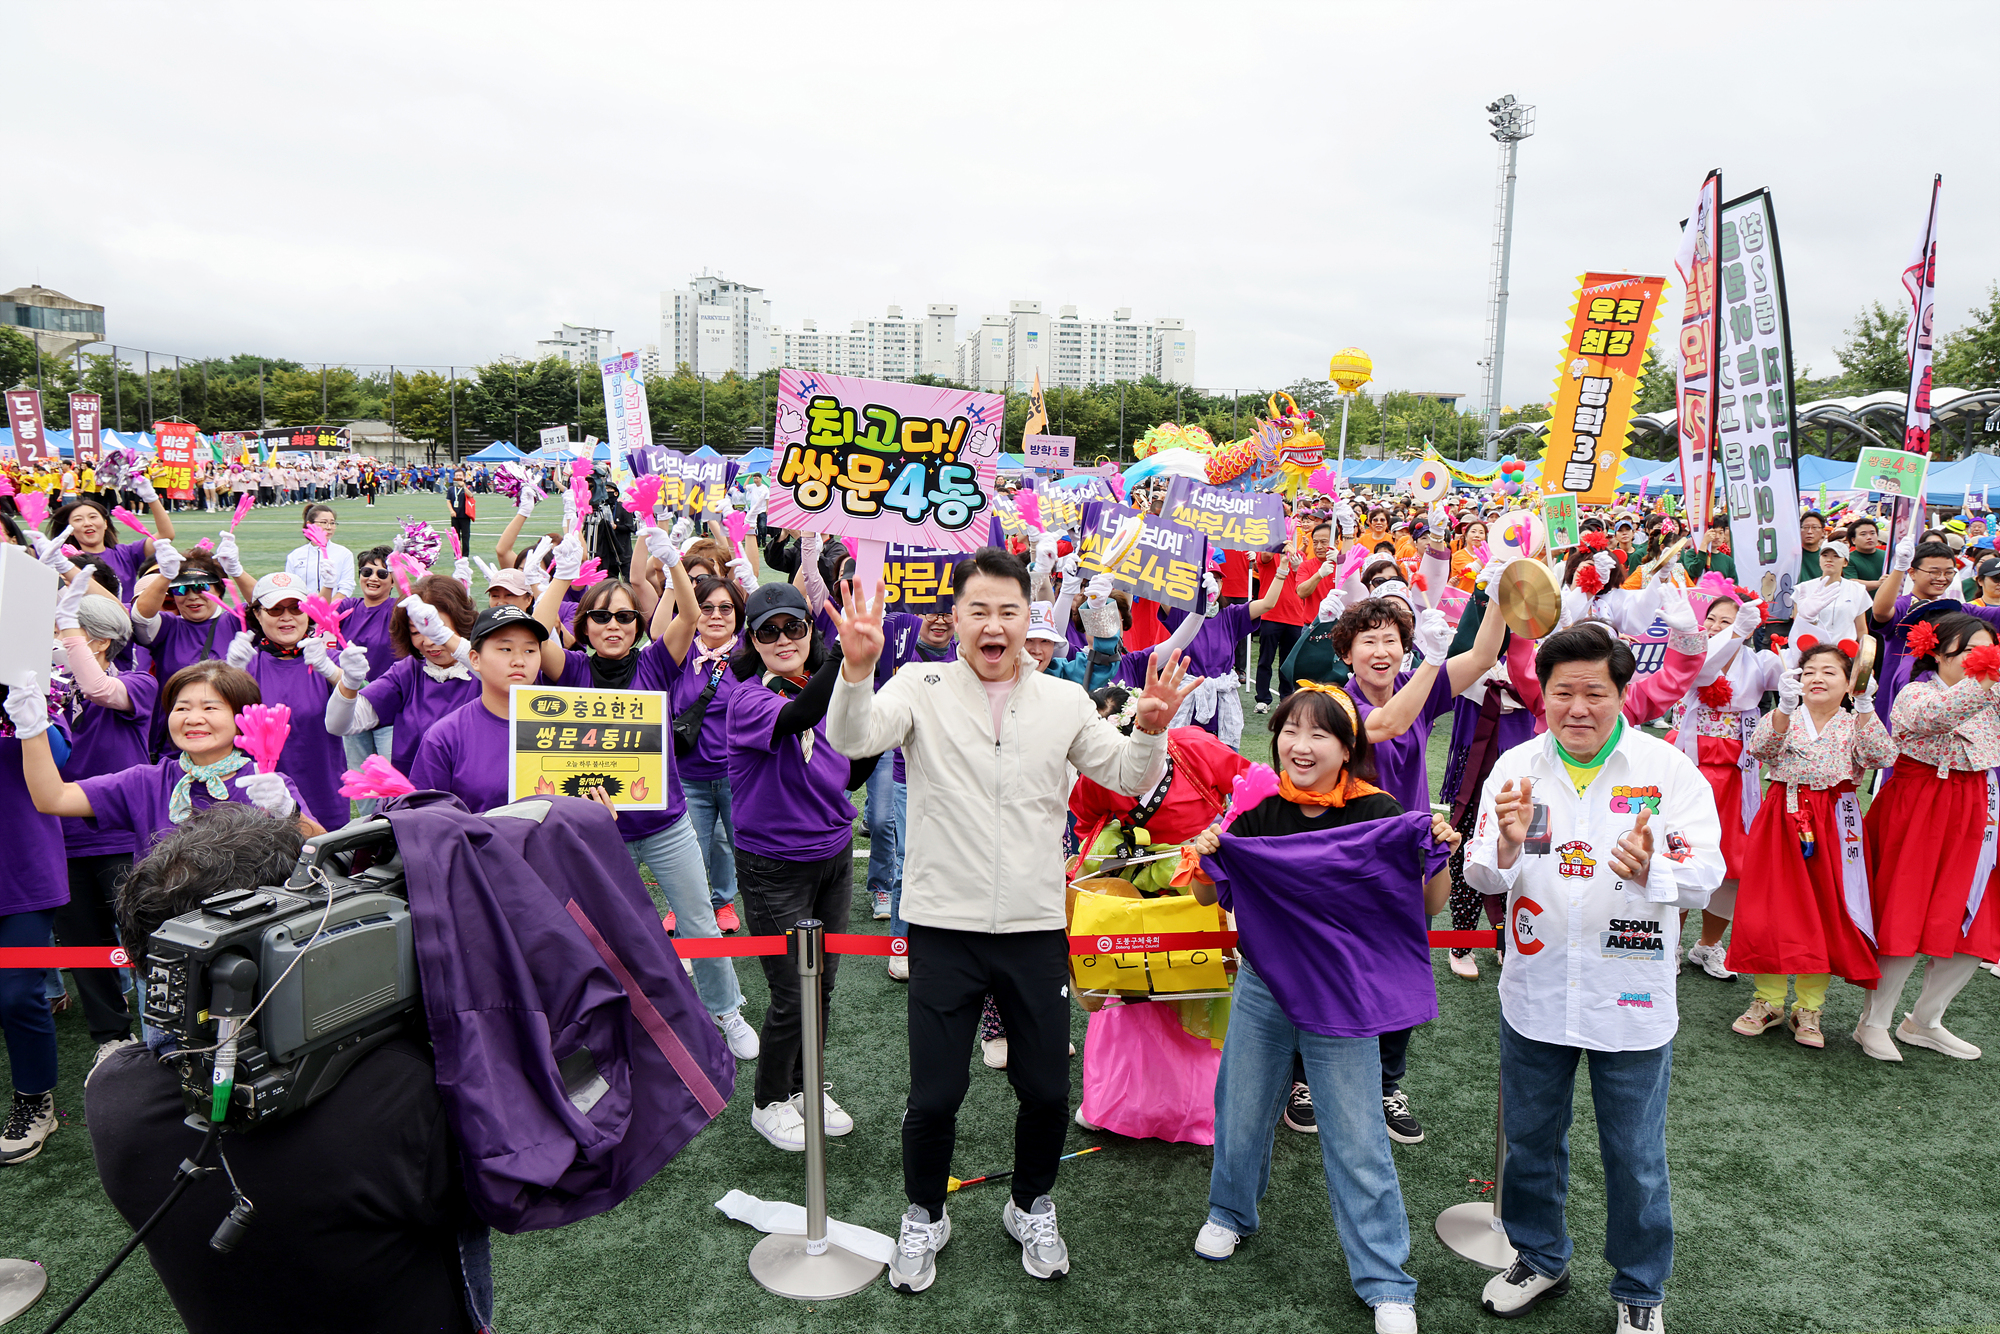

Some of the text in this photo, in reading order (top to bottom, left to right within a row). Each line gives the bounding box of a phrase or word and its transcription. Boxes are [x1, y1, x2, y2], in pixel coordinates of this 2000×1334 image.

[1587, 297, 1644, 325] 우주
[1579, 328, 1634, 357] 최강
[604, 355, 640, 376] 도봉1동
[625, 384, 640, 410] 우리
[73, 401, 99, 412] 우리가
[806, 397, 968, 463] 최고다!
[1563, 376, 1613, 492] 방학3동
[161, 436, 190, 449] 비상
[267, 436, 290, 447] 바로
[291, 434, 317, 447] 최강
[163, 450, 191, 463] 하는
[1030, 444, 1070, 458] 방학1동
[1868, 456, 1917, 473] 쌍문4동
[779, 446, 983, 527] 쌍문4동
[537, 700, 561, 713] 필/독
[536, 726, 642, 750] 쌍문4동!!
[1611, 785, 1662, 798] SEOUL
[1609, 795, 1662, 815] GTX
[1842, 799, 1860, 859] 쌍문4동
[1560, 864, 1593, 876] 안병건
[1518, 922, 1534, 936] GTX
[1609, 918, 1663, 934] SEOUL
[1115, 936, 1160, 946] 도봉구체육회
[1605, 935, 1664, 951] ARENA
[214, 1071, 221, 1081] 3
